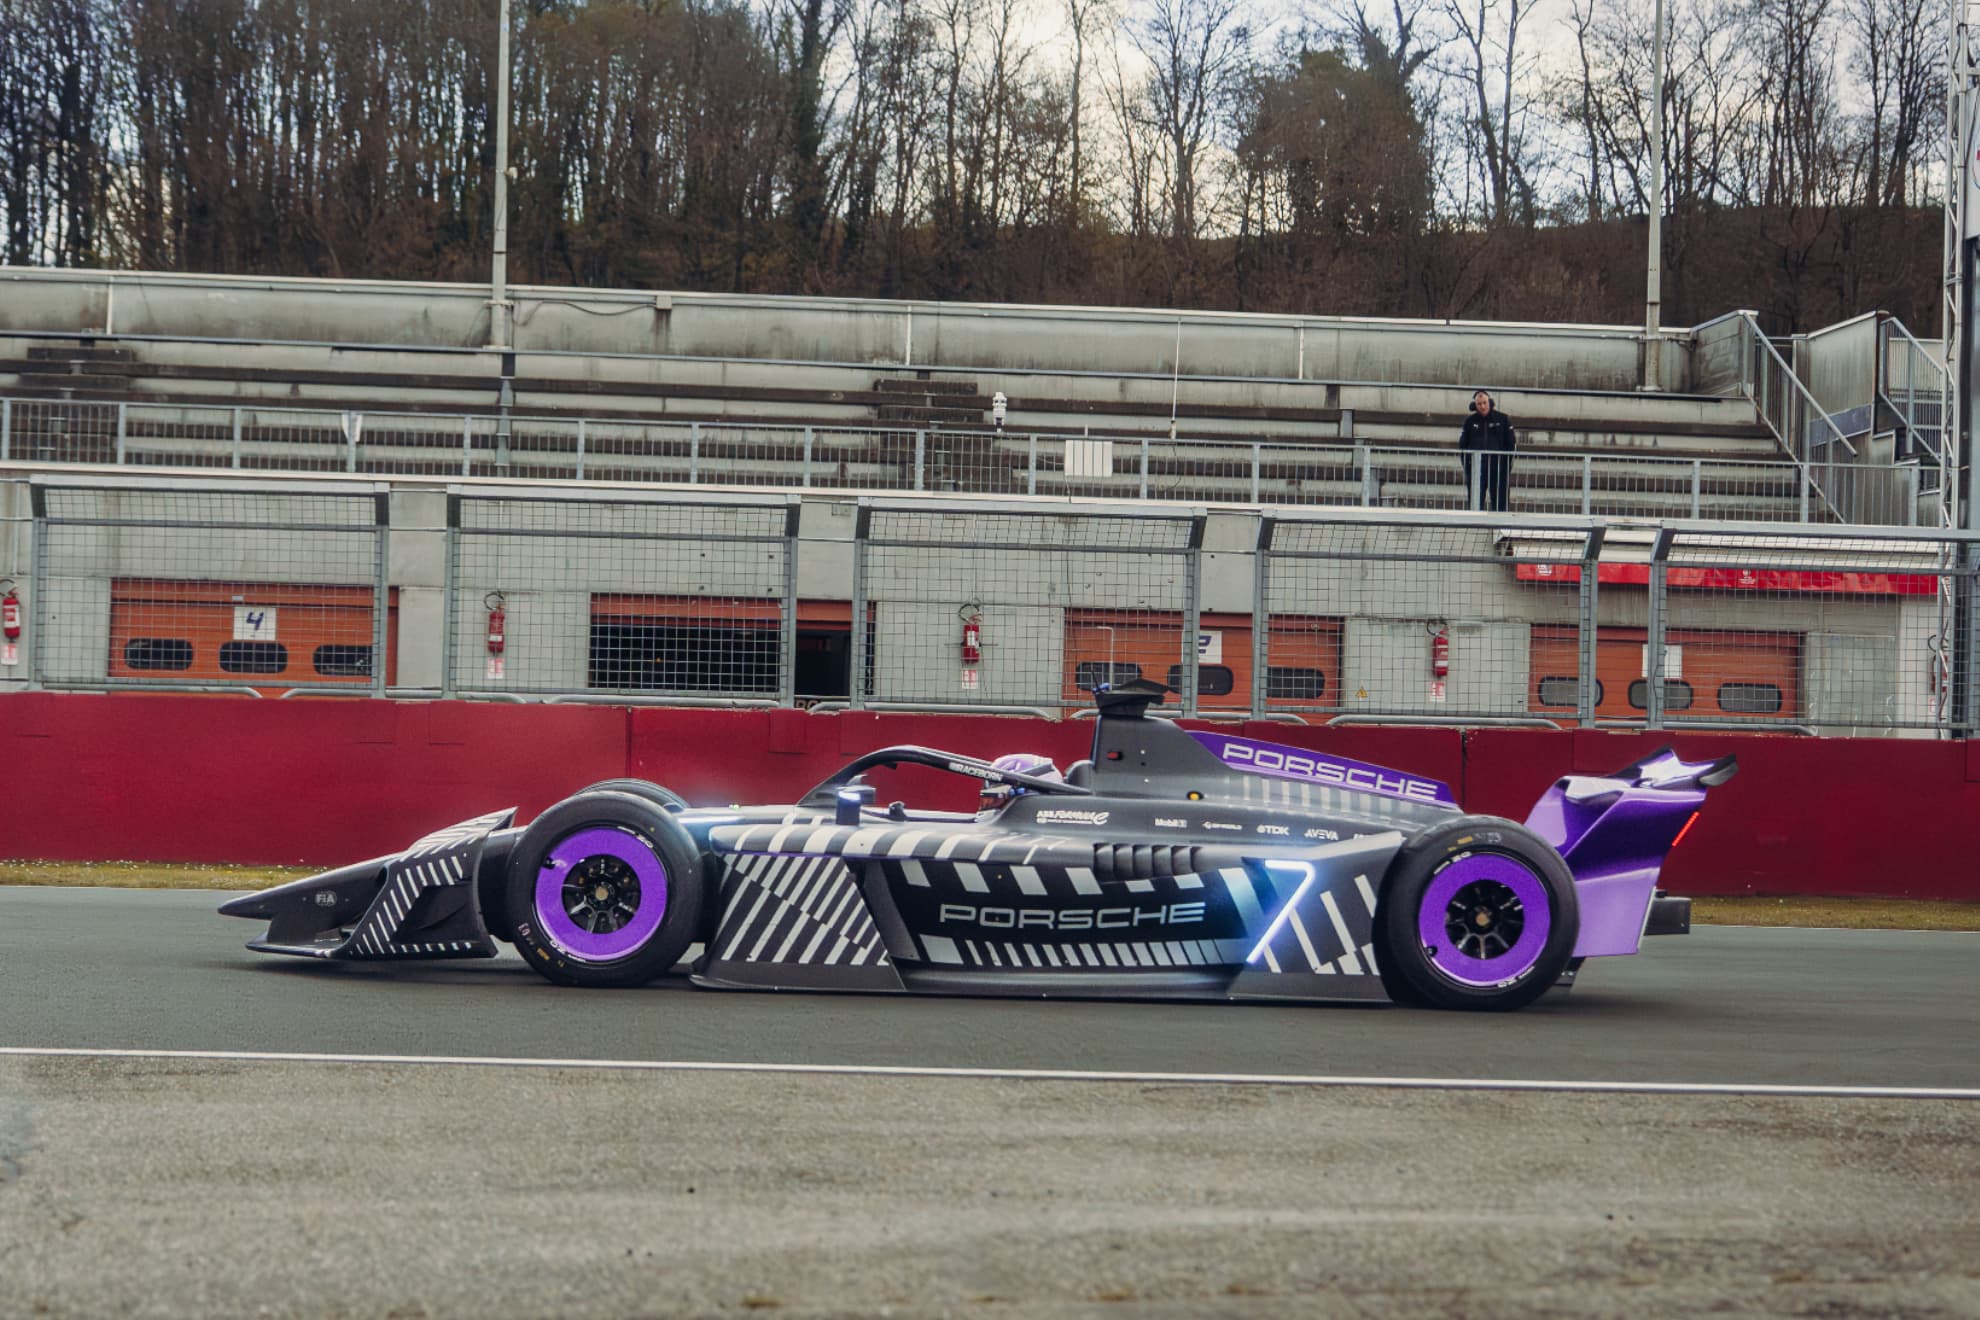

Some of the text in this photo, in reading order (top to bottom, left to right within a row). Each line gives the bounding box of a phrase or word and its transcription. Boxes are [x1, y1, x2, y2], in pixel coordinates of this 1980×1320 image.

[246, 611, 265, 631] 4
[1222, 742, 1439, 801] PORSCHE
[1265, 824, 1291, 837] TDK
[1303, 828, 1340, 841] AVEVA
[315, 893, 336, 905] FIA
[939, 901, 1206, 930] PORSCHE
[1245, 859, 1316, 965] 7
